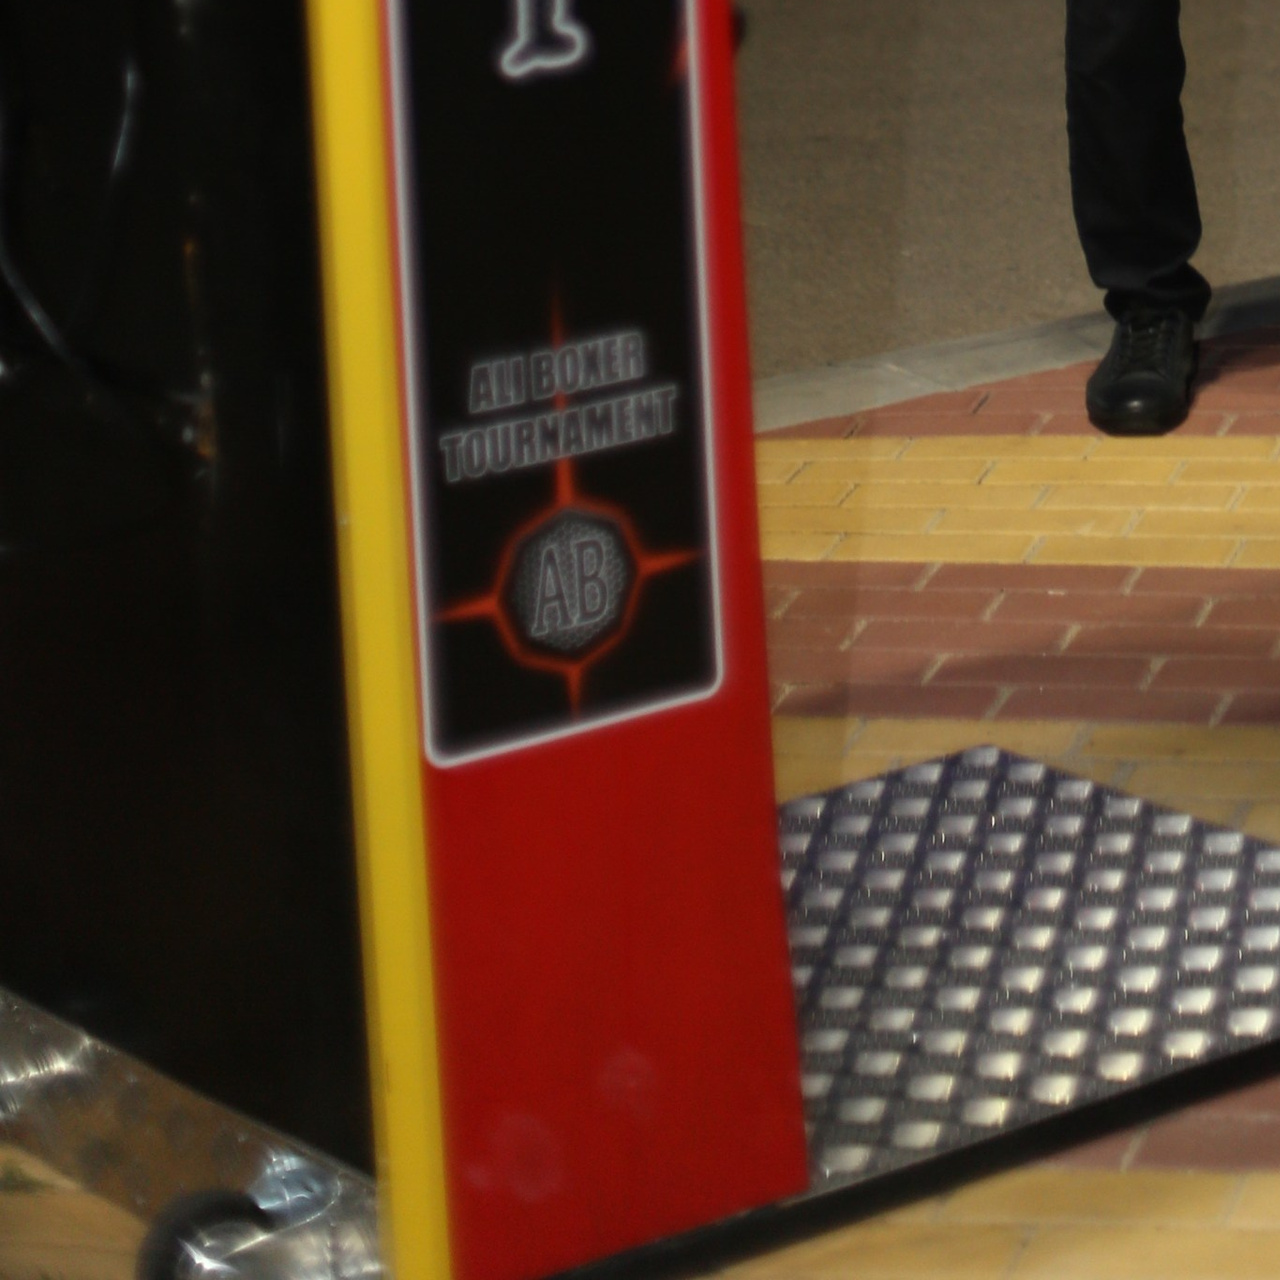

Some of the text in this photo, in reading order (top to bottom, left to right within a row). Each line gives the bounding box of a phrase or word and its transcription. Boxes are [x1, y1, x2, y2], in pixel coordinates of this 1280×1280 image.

[468, 331, 647, 415] ALI BOXER
[439, 382, 680, 483] TOURNAMENT
[531, 537, 610, 637] AB
